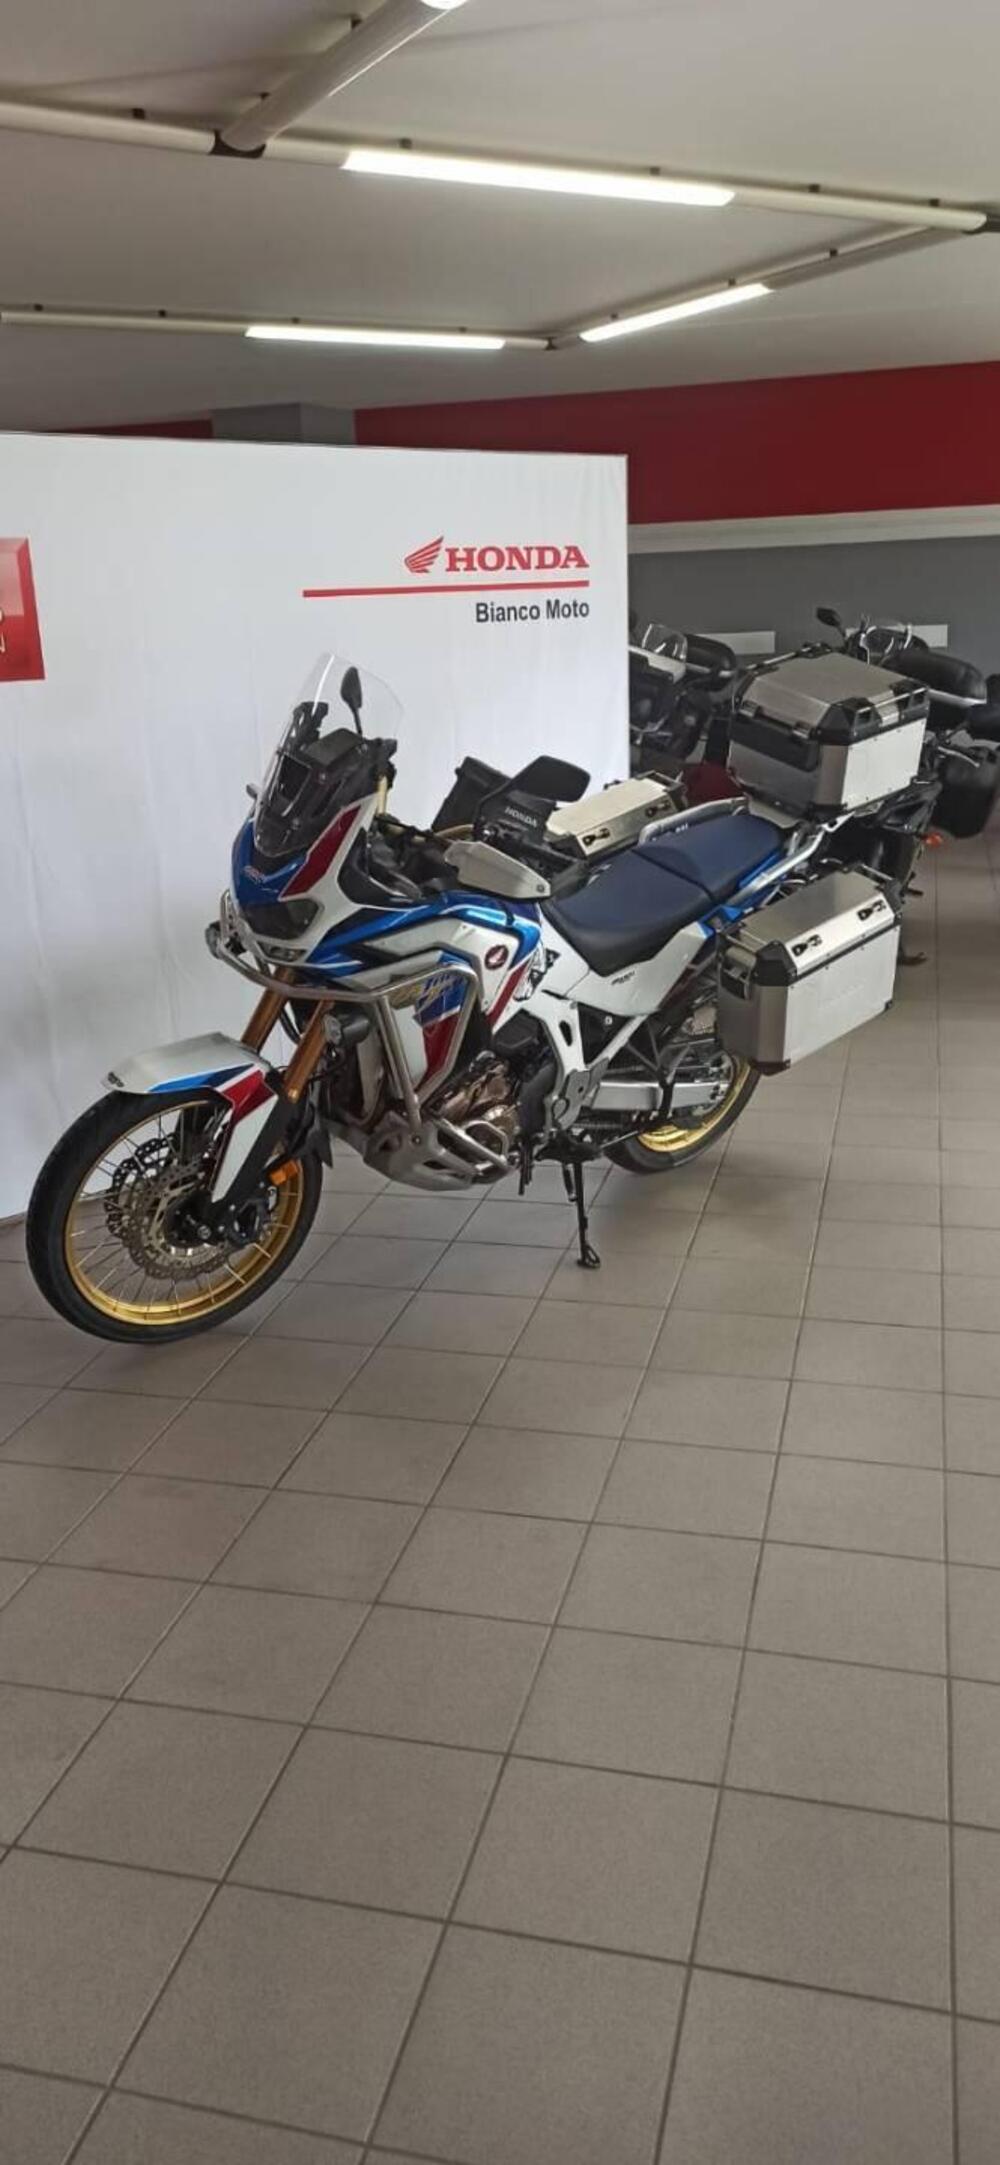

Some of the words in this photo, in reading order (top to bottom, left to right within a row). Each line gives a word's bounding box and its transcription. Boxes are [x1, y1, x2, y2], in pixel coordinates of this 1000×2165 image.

[445, 545, 589, 572] HONDA
[475, 601, 541, 623] Bianco
[546, 599, 590, 619] Moto
[504, 806, 538, 828] HONDA
